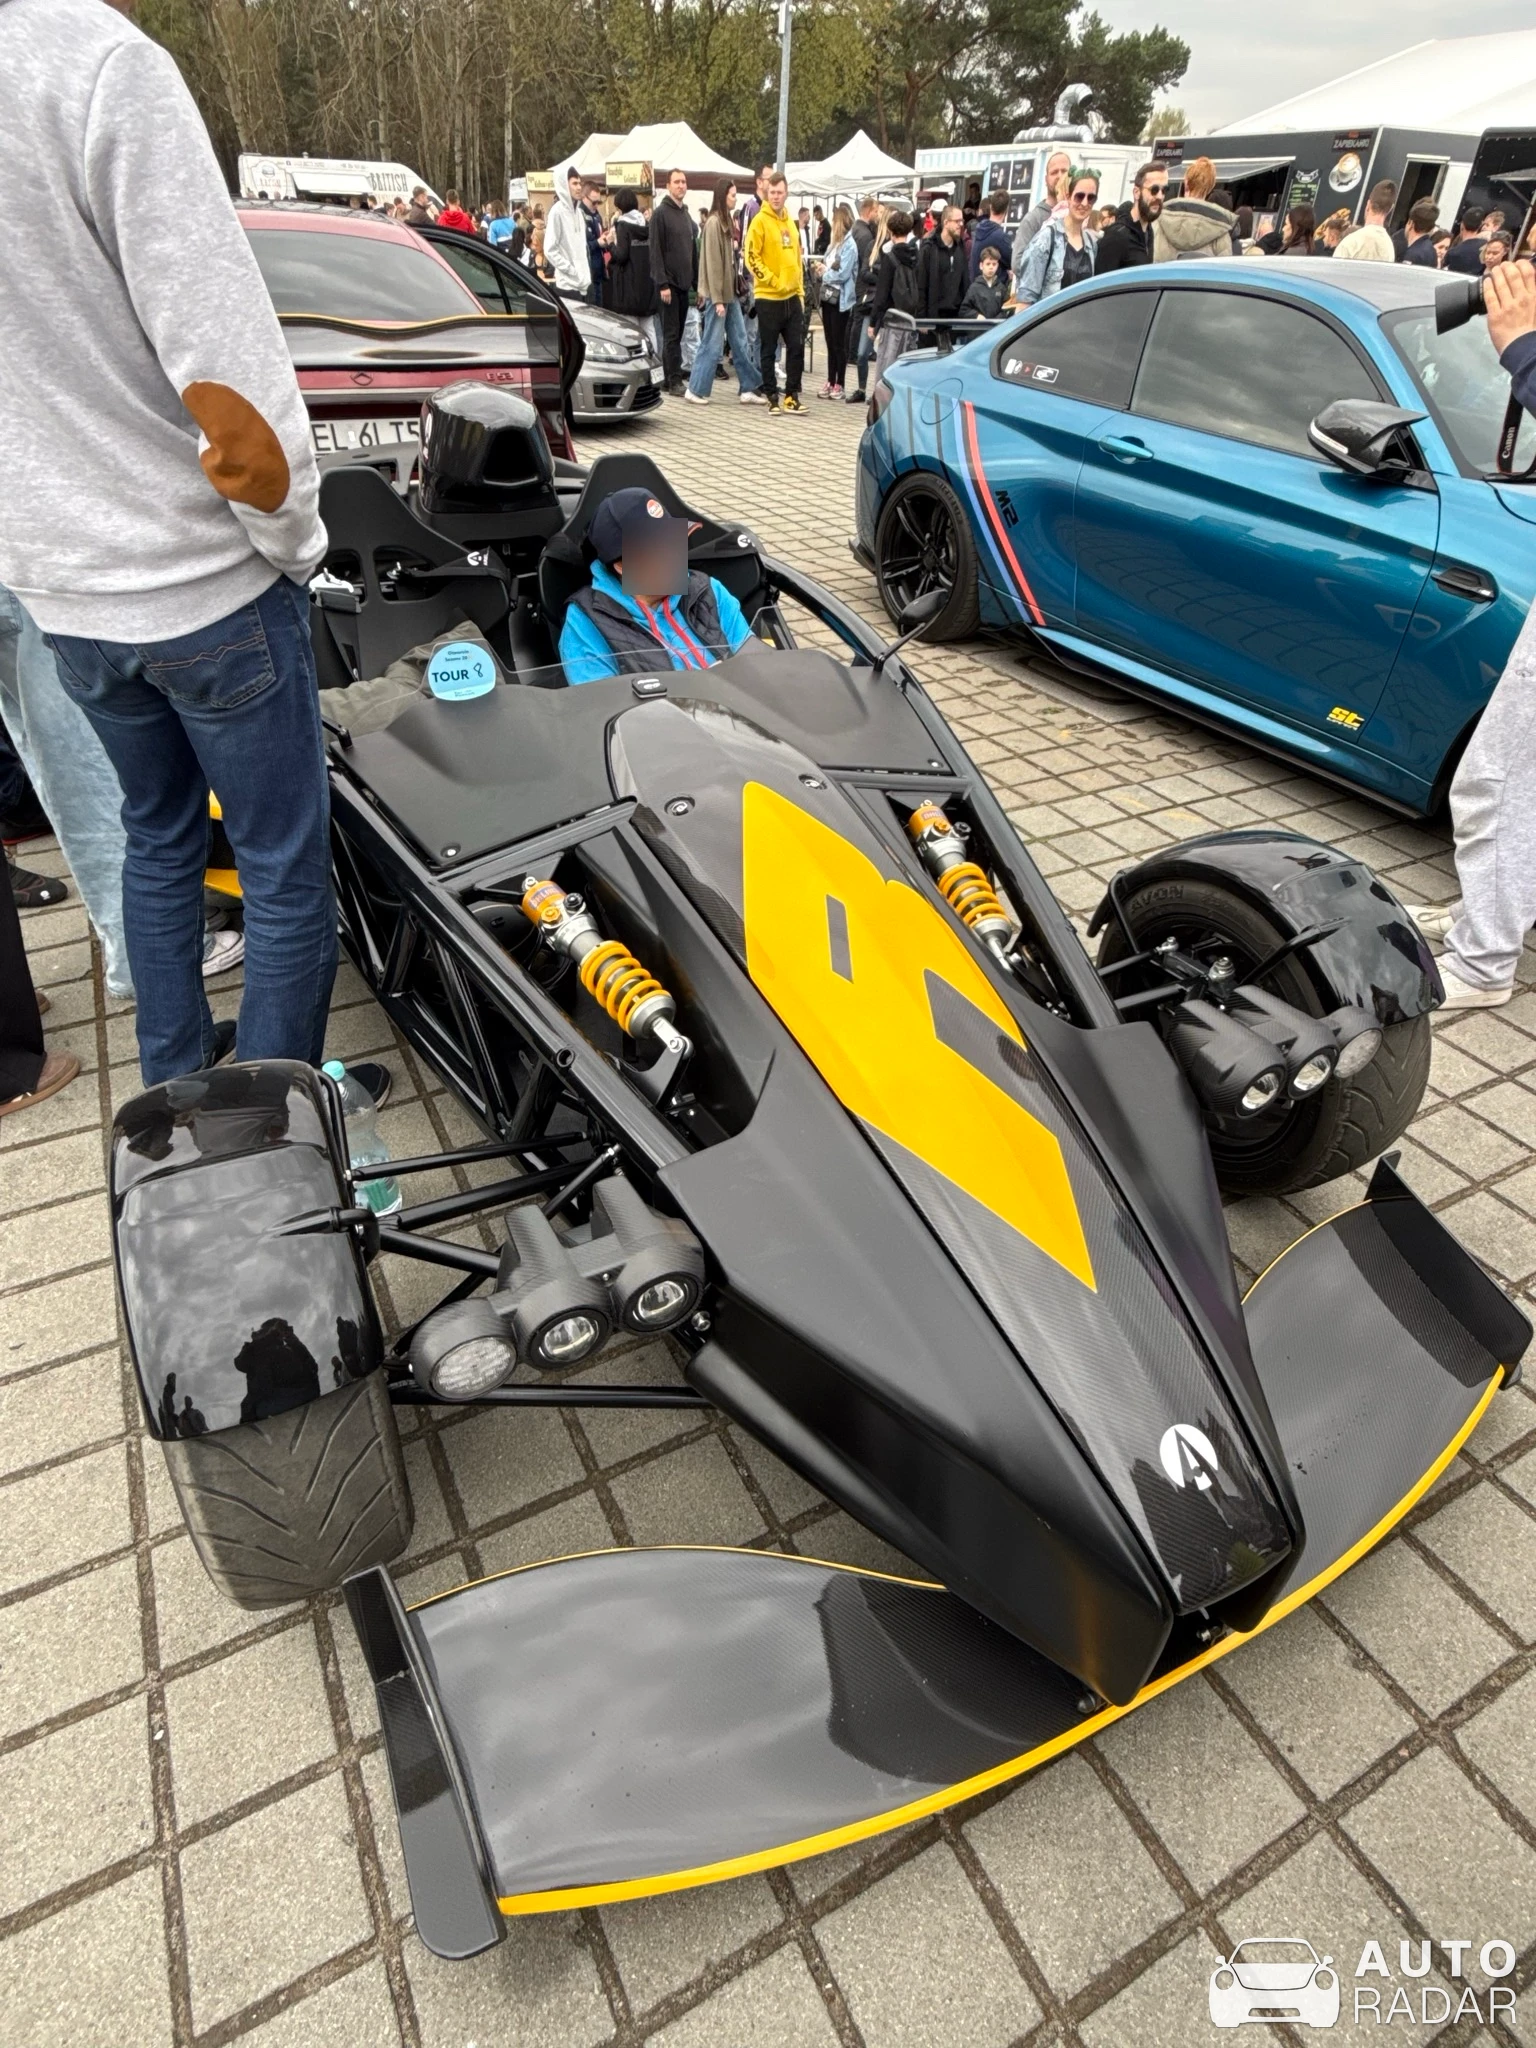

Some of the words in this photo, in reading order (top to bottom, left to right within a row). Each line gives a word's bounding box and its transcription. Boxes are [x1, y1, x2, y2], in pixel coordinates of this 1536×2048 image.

[370, 172, 408, 193] BRITISH
[311, 422, 349, 452] EL
[1502, 426, 1516, 459] Canon
[995, 490, 1019, 528] M2
[431, 669, 470, 683] TOUR
[1131, 885, 1184, 914] AVON
